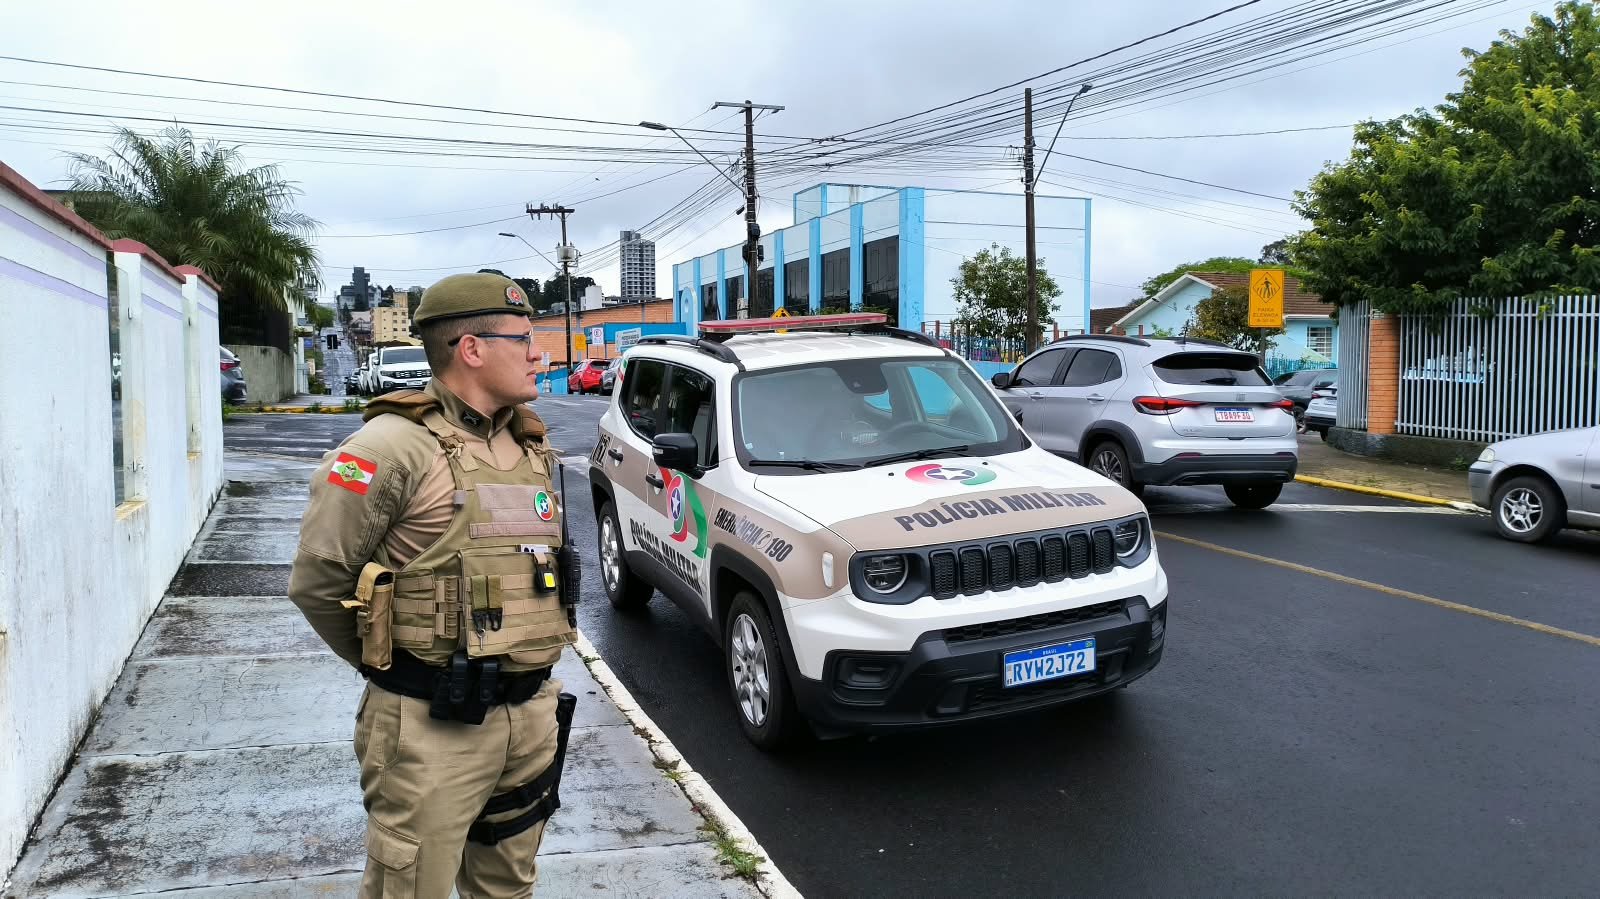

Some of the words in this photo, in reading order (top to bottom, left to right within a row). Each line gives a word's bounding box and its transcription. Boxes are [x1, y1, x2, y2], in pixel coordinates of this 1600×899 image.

[894, 499, 1007, 532] POLÍCIA
[999, 491, 1106, 512] MILITAR
[764, 537, 794, 562] 190
[1042, 648, 1057, 656] BRASIL
[1013, 651, 1086, 682] RYW2J72
